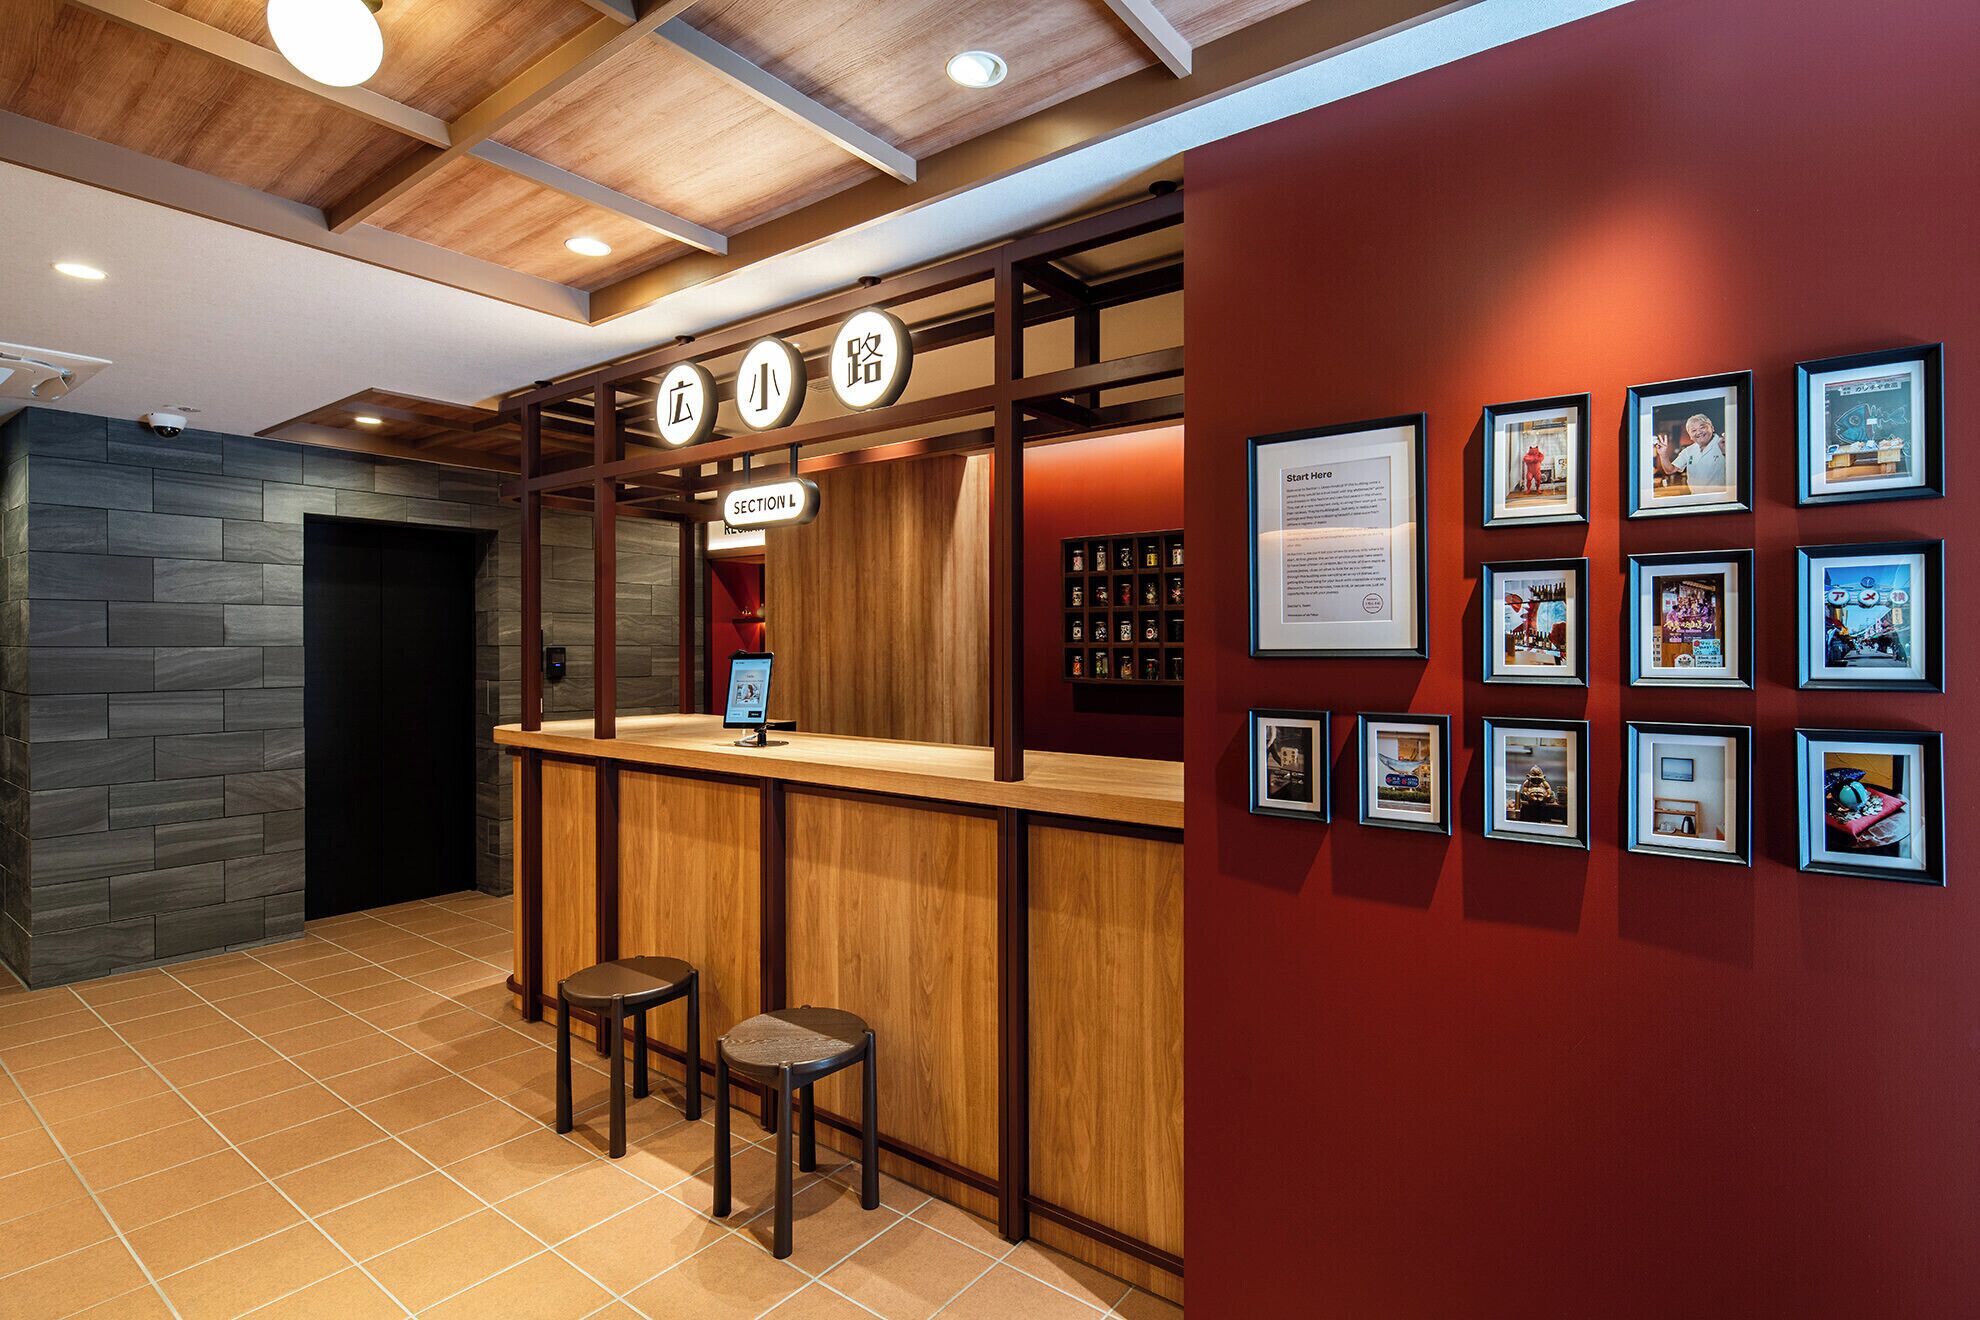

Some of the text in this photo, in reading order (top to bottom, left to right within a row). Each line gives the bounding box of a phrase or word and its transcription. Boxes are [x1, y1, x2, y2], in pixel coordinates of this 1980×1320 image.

[668, 332, 883, 426] 広小路
[1286, 471, 1332, 482] Start Here
[734, 494, 796, 514] SECTION L
